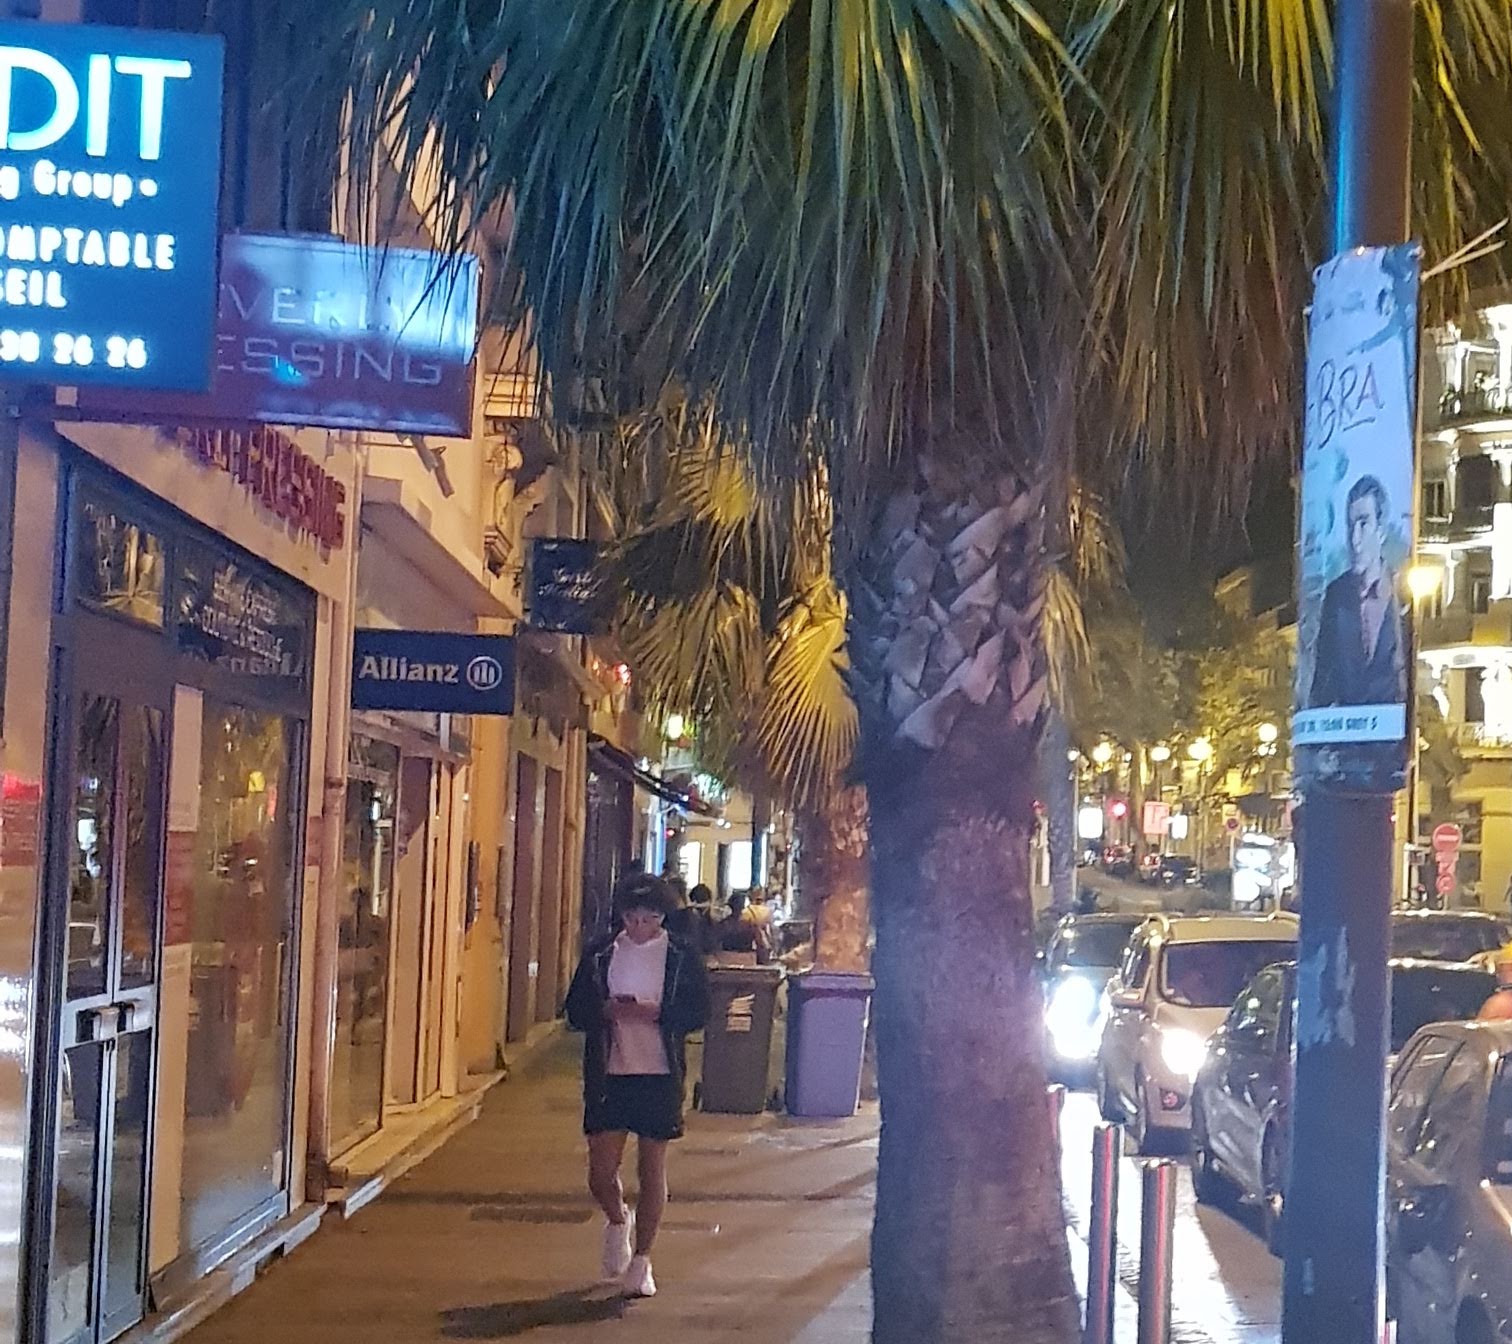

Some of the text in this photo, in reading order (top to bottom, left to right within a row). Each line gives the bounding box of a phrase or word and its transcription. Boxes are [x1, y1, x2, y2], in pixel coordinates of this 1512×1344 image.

[34, 159, 133, 207] Group
[0, 224, 175, 270] MPTABLE
[0, 268, 67, 308] EIL
[358, 655, 459, 684] Allianz
